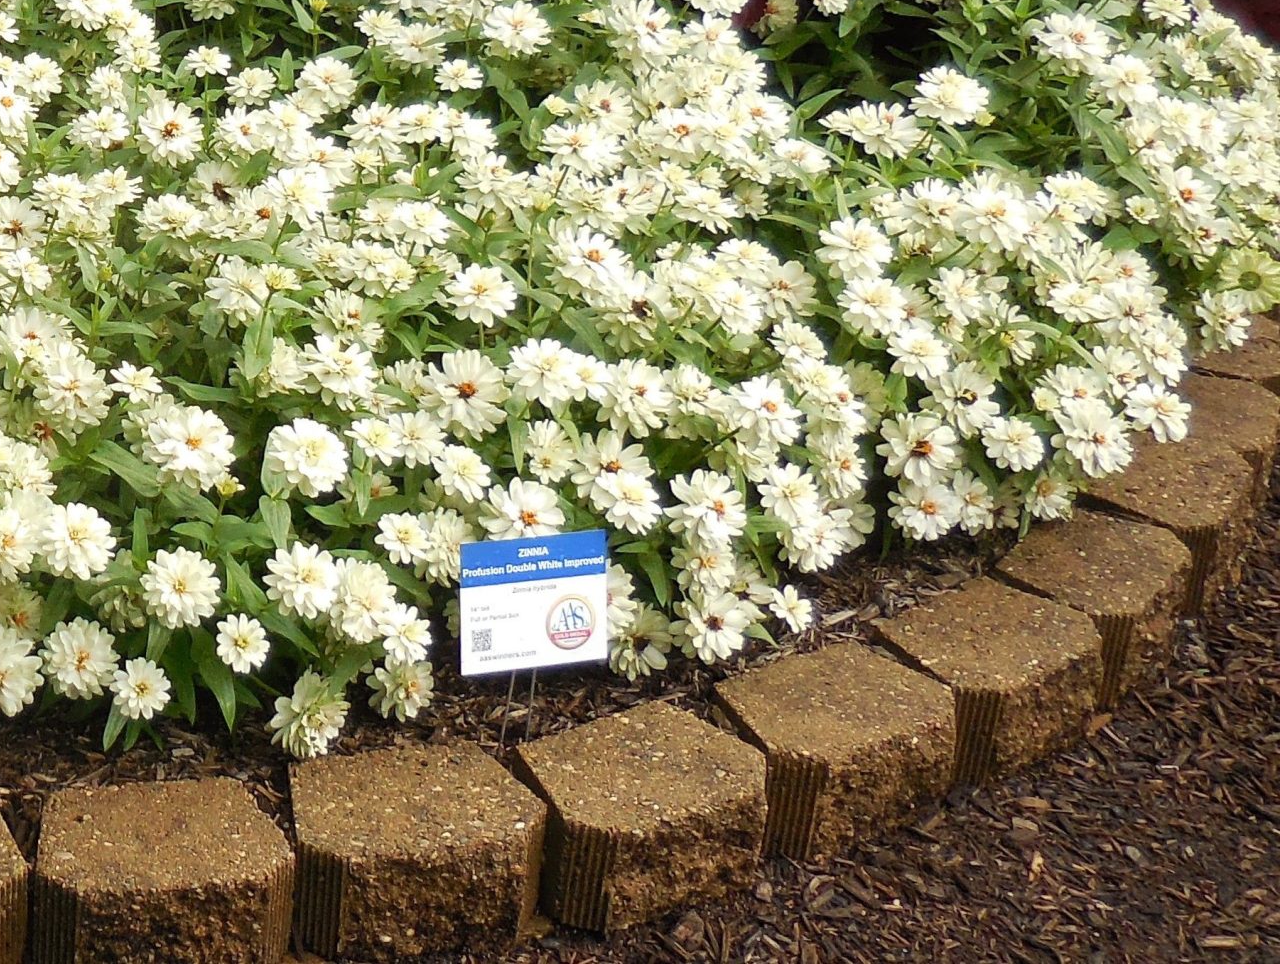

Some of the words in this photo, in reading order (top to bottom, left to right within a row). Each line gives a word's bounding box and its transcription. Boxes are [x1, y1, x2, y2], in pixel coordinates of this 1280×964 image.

[518, 546, 549, 558] ZINNIA
[463, 565, 504, 578] Profusion
[506, 561, 536, 574] Double
[538, 559, 563, 570] White
[564, 555, 605, 569] Improved
[556, 602, 585, 632] AAS
